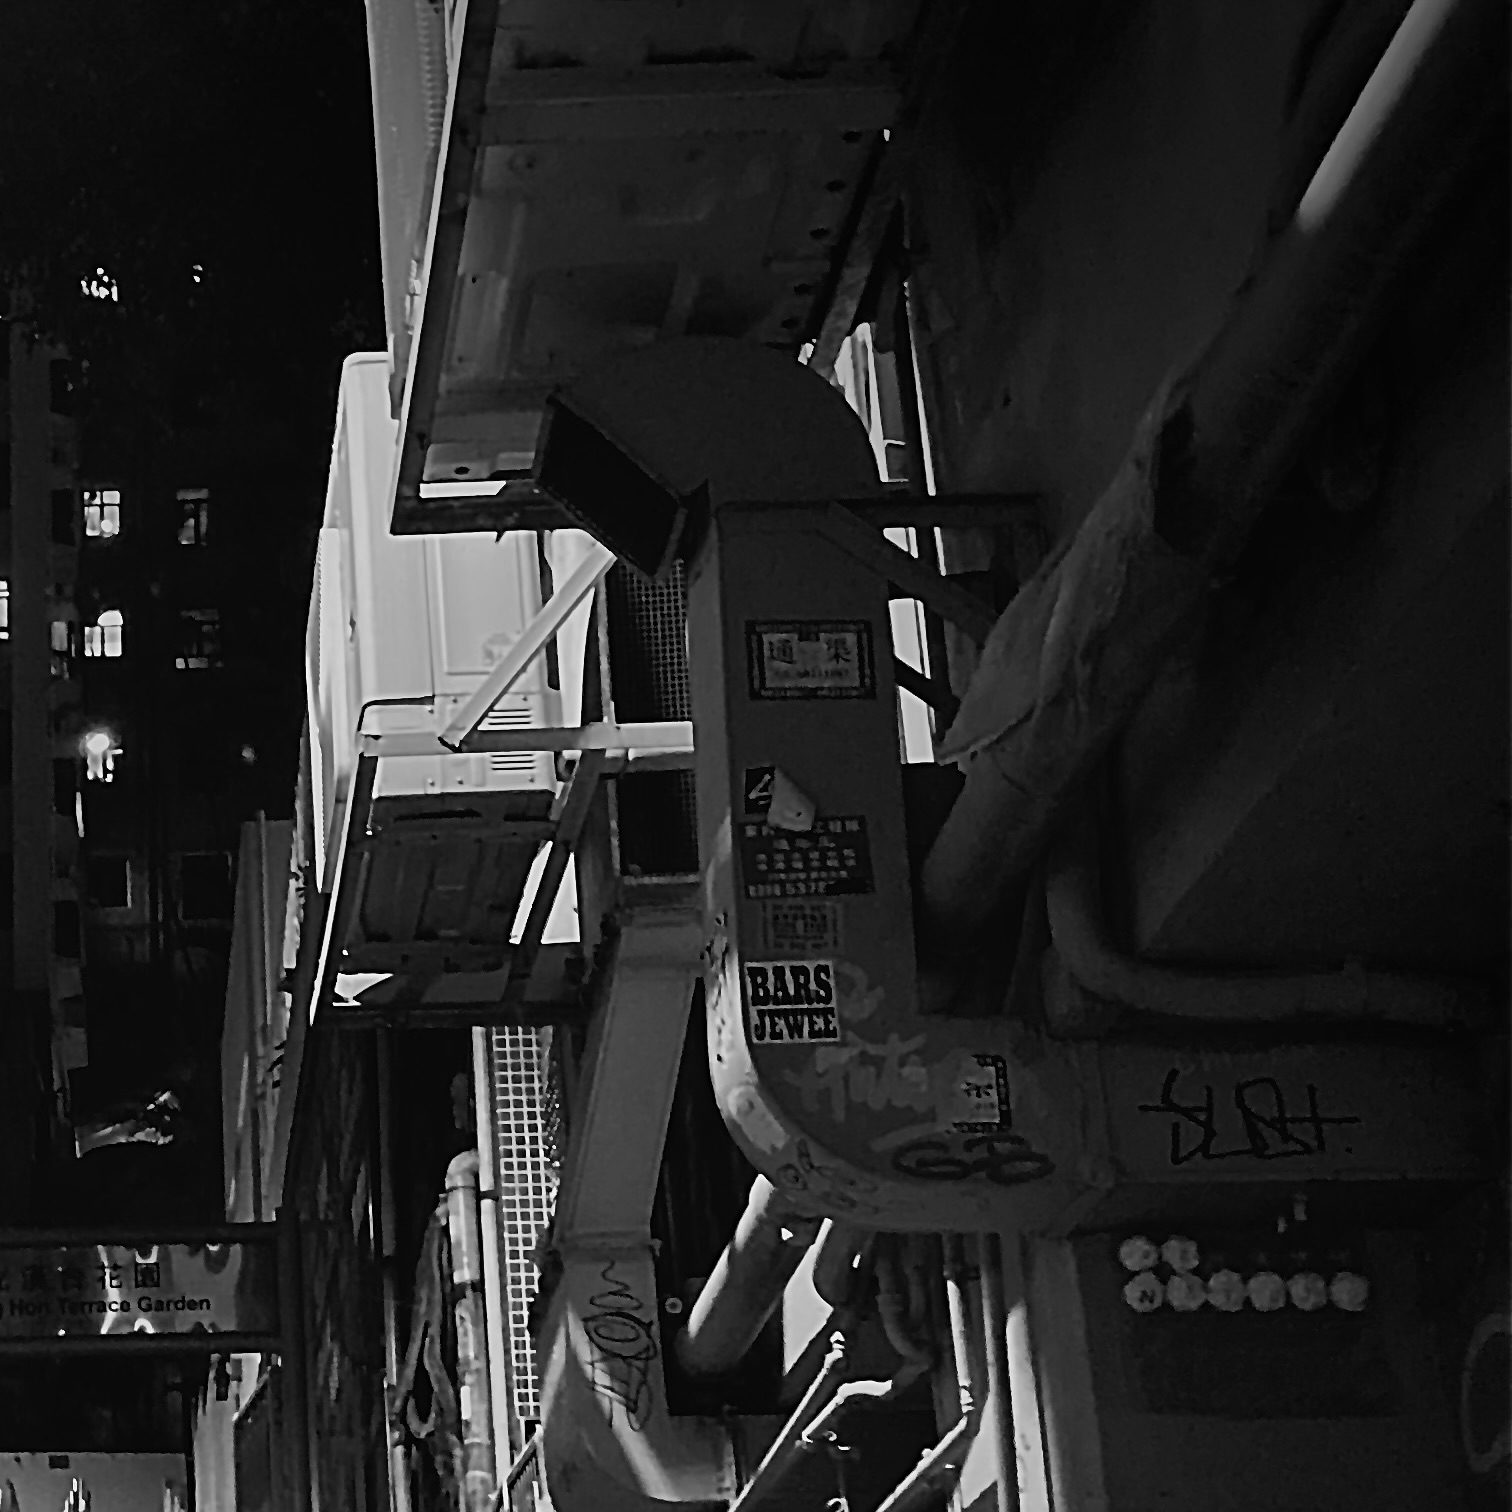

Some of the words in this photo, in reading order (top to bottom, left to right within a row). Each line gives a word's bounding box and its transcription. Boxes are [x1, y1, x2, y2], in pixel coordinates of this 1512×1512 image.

[746, 964, 832, 1006] BARS
[755, 1007, 837, 1041] JEWEE
[57, 1297, 131, 1315] Terrace
[137, 1296, 210, 1313] Garden
